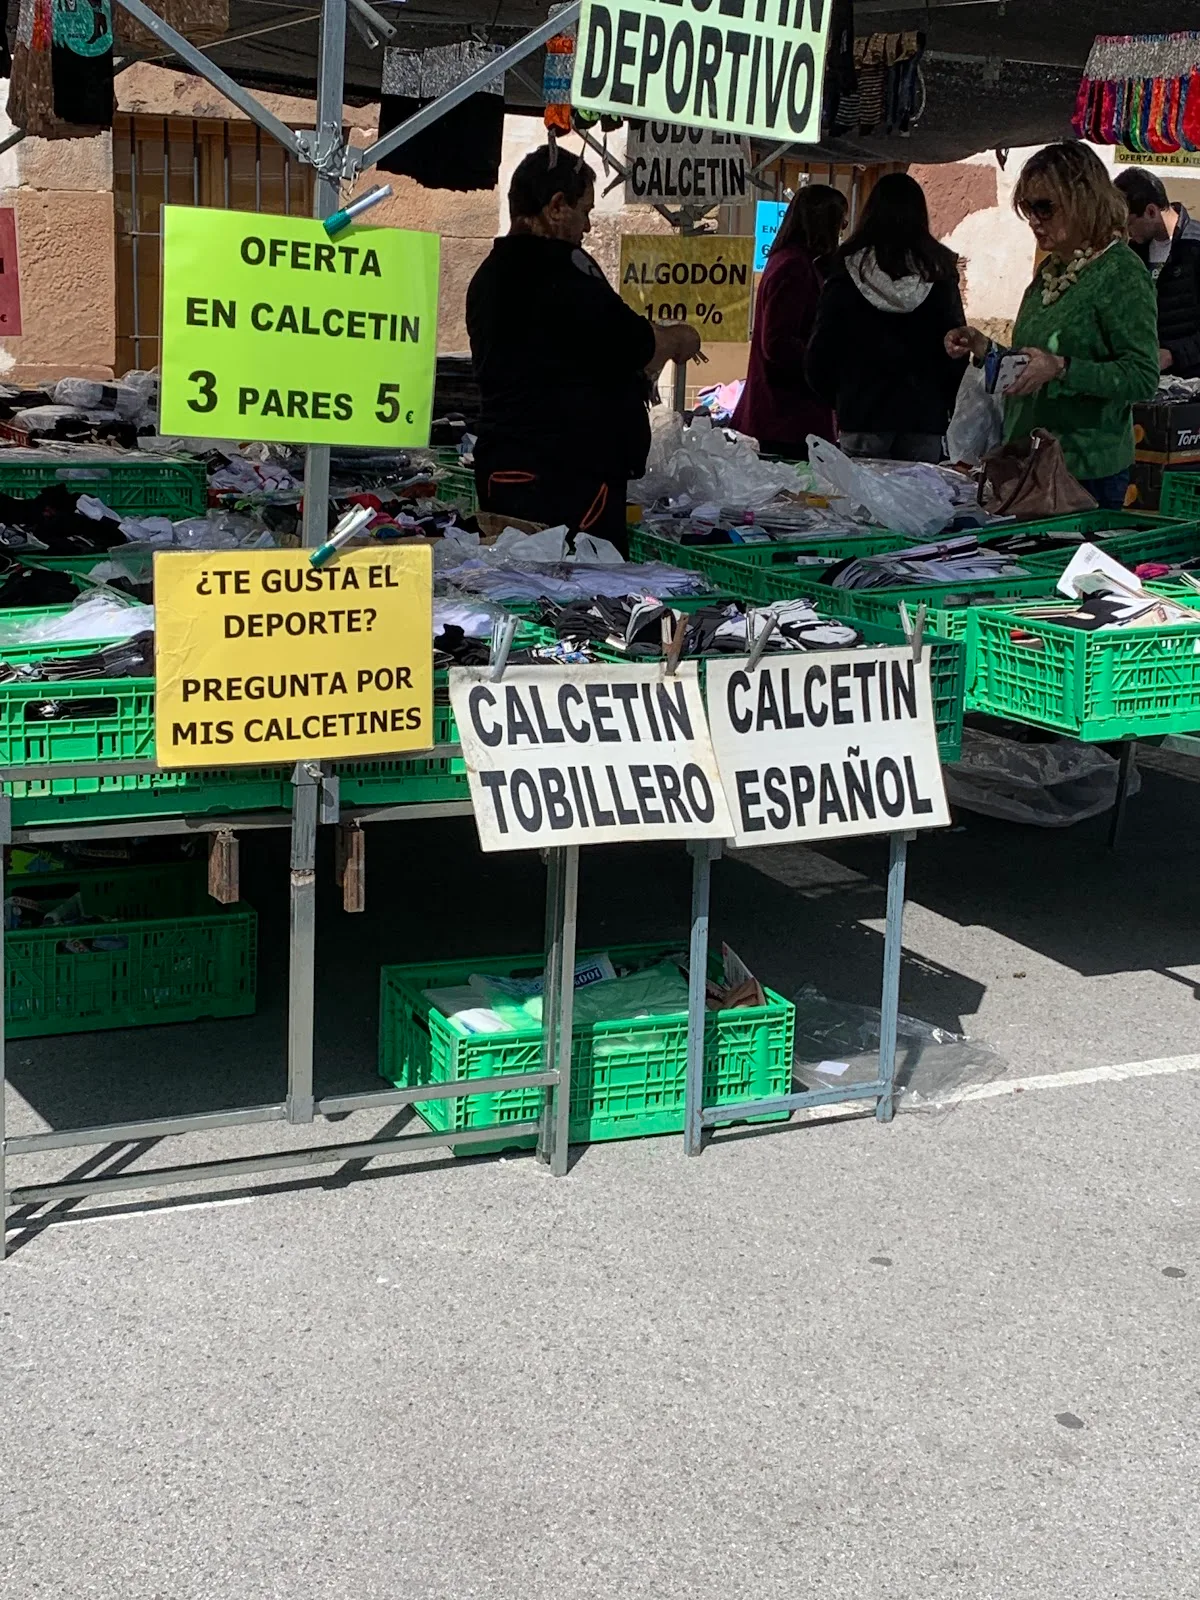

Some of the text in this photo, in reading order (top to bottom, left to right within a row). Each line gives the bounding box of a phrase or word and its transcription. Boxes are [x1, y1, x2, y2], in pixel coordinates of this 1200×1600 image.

[580, 3, 815, 134] DEPORTIVO
[632, 157, 745, 196] CALCETIN
[1119, 154, 1153, 162] OFERTA
[240, 236, 382, 277] OFERTA
[623, 256, 747, 285] ALGODÓN
[186, 297, 419, 343] EN CALCETIN
[645, 303, 723, 325] 100 %
[187, 370, 218, 413] 3
[239, 387, 353, 421] PARES
[196, 565, 399, 596] ¿TE GUSTA EL
[224, 608, 377, 639] DEPORTE?
[182, 666, 413, 702] PREGUNTA POR
[727, 659, 918, 734] CALCETIN
[172, 707, 422, 746] MIS CALCETINES
[468, 681, 695, 747] CALCETIN
[479, 762, 715, 834] TOBILLERO
[735, 745, 933, 833] ESPAÑOL
